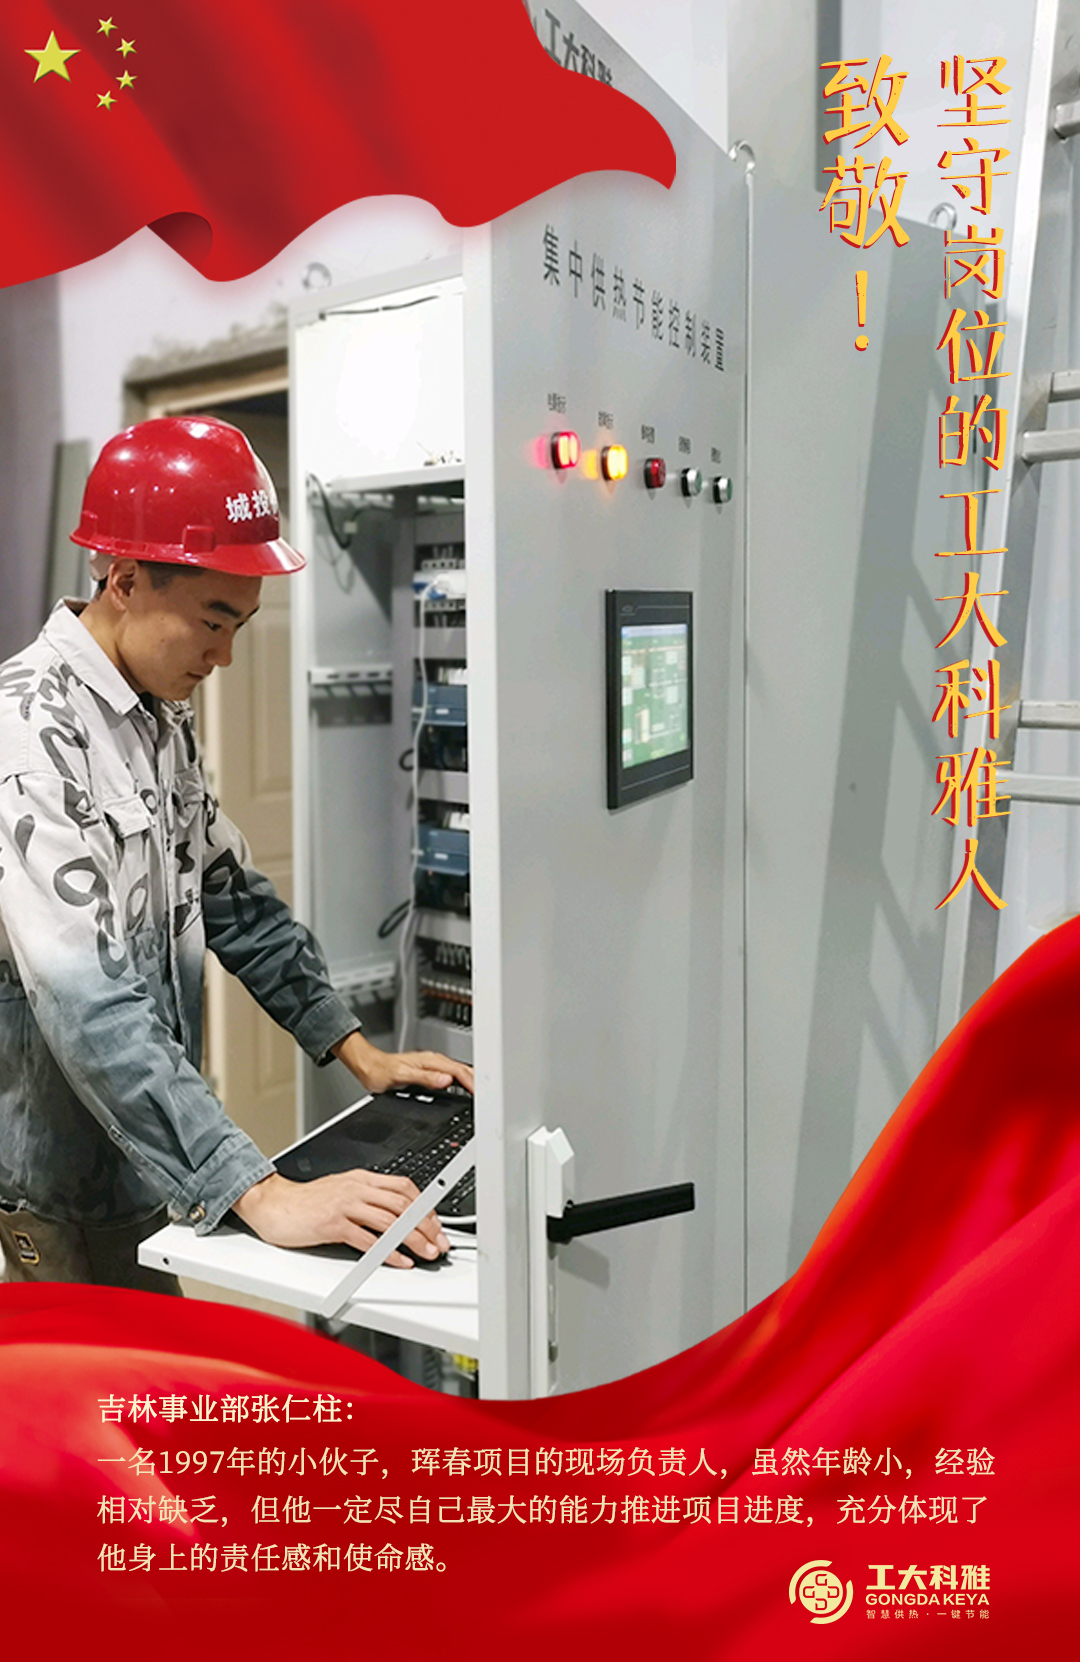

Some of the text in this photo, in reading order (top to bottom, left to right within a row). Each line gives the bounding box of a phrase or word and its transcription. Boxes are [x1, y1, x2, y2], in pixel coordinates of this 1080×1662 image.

[543, 223, 724, 372] 集中供热节能控制装置
